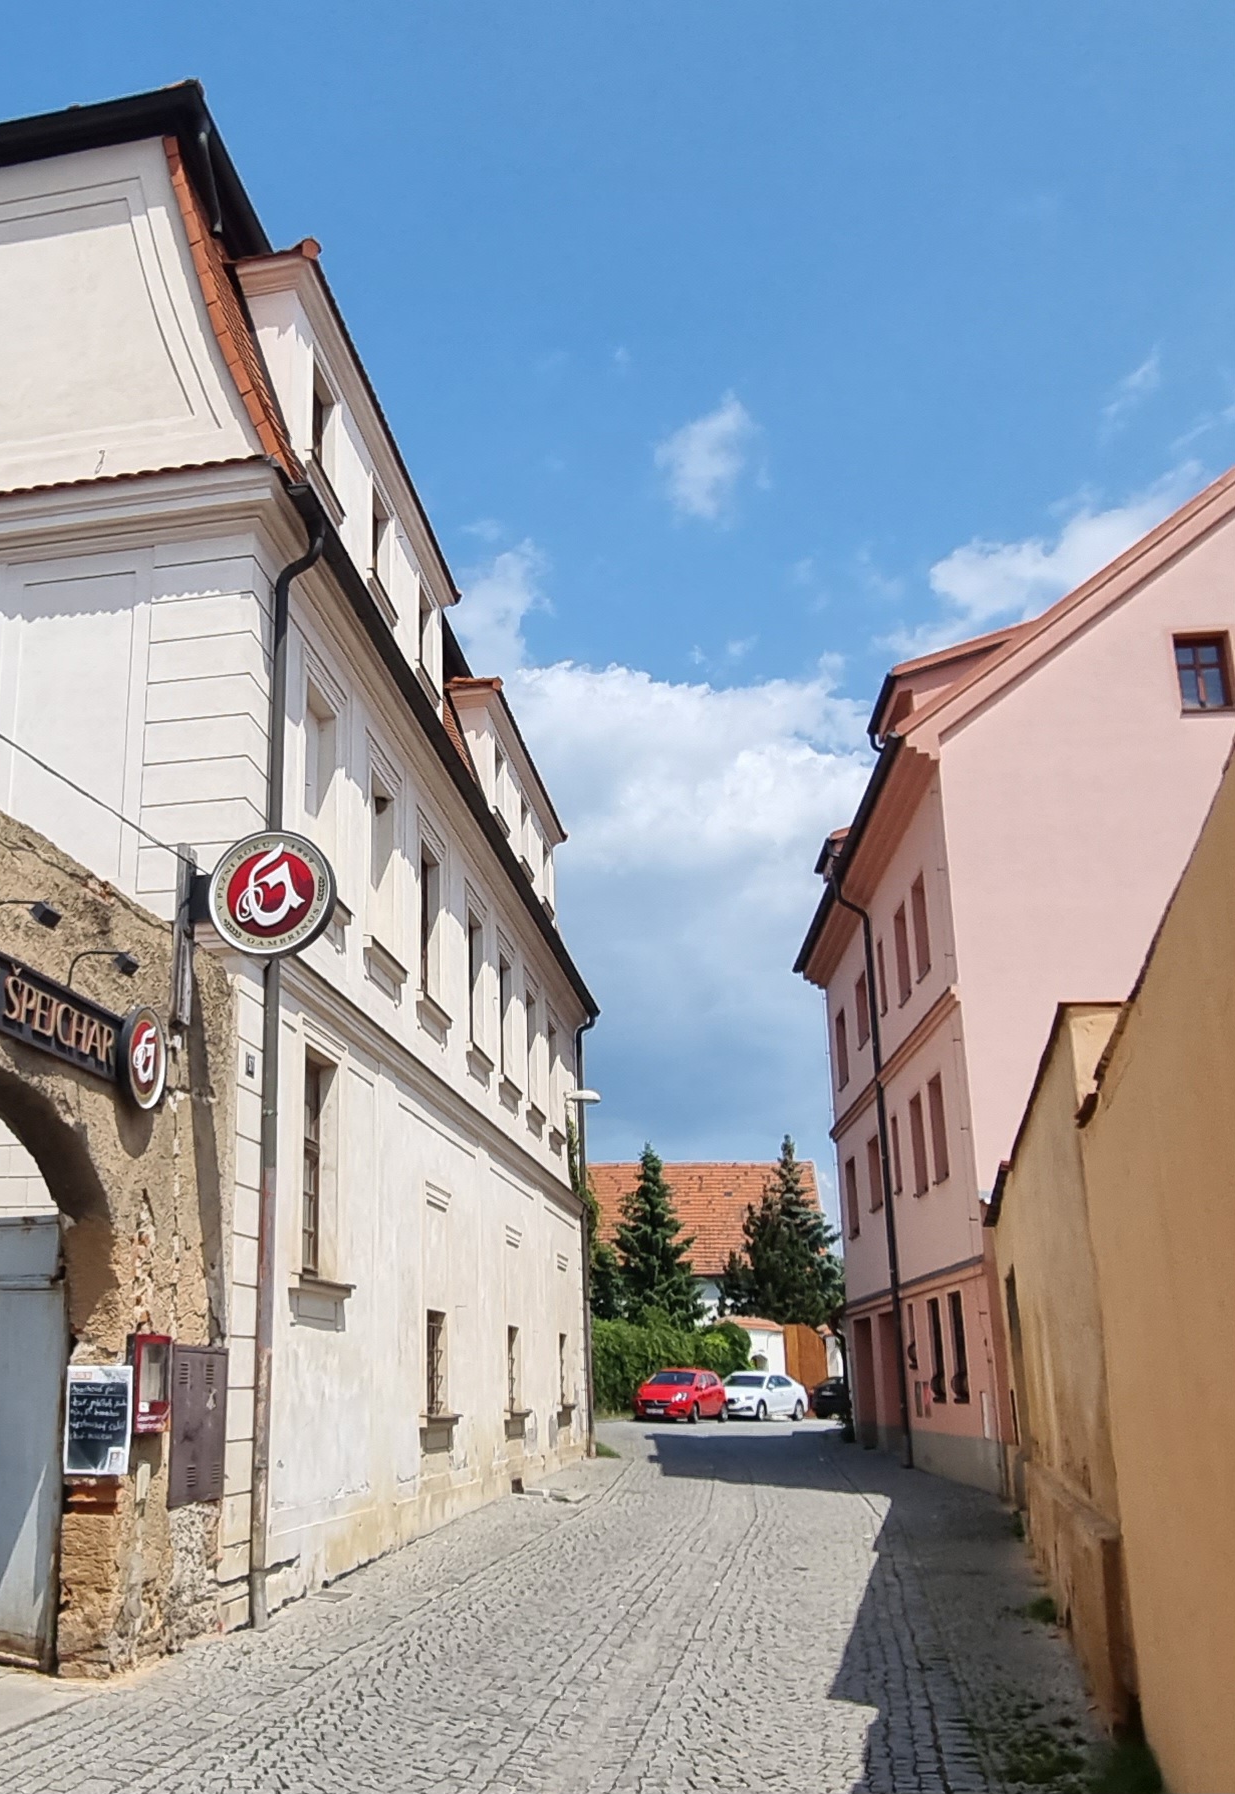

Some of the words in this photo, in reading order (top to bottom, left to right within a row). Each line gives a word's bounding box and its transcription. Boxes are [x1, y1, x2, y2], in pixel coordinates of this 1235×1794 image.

[217, 863, 236, 899] PLZNI
[237, 841, 270, 861] ROKU
[247, 908, 320, 946] GAMBRINUS
[3, 963, 115, 1063] ŠPEJCHAR
